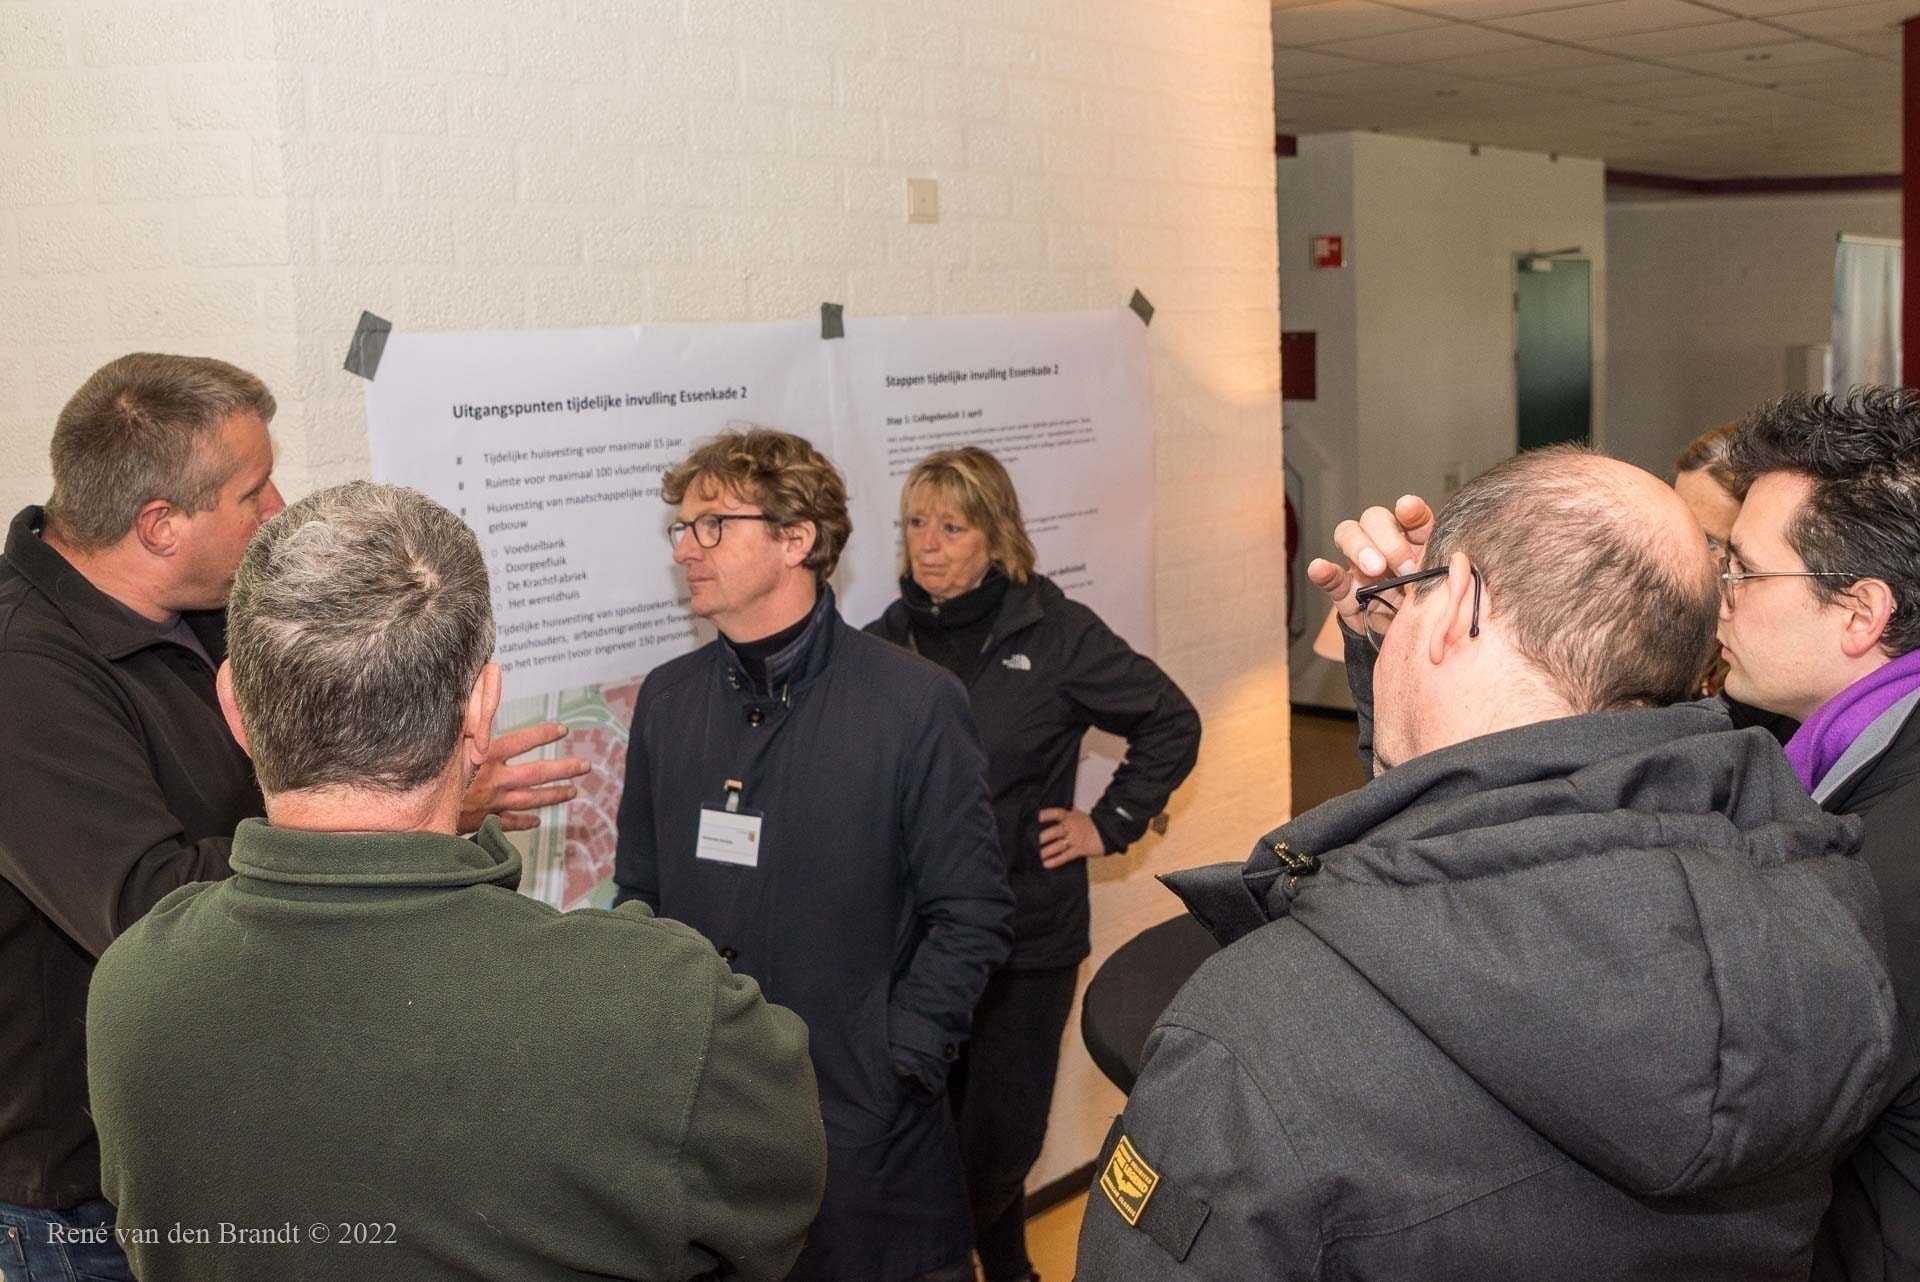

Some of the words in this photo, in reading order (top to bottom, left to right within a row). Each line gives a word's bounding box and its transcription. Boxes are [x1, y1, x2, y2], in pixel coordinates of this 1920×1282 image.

[886, 375, 924, 388] Stappen
[927, 370, 967, 386] tijdelijke
[970, 368, 1007, 381] invulling
[1009, 365, 1053, 379] Essenkade
[1054, 363, 1060, 376] 2
[453, 400, 563, 420] Uitgangspunten
[566, 395, 622, 413] tijdelijke
[625, 391, 677, 407] invulling
[680, 386, 738, 404] Essenkade
[741, 385, 748, 399] 2
[484, 450, 529, 466] Tijdelijke
[531, 446, 584, 461] huisvesting
[586, 445, 606, 455] voor
[609, 439, 651, 453] maximaal
[653, 438, 664, 449] 15
[485, 475, 521, 489] Ruimte
[524, 473, 546, 485] voor
[549, 468, 593, 482] maximaal
[596, 466, 613, 479] 100
[487, 498, 545, 514] Huisvesting
[546, 497, 563, 508] van
[565, 487, 643, 506] maatschappelijke
[489, 519, 528, 535] gebouw
[504, 538, 566, 555] Voedselbank
[506, 555, 567, 573] Doorgeefluik
[507, 580, 520, 592] De
[509, 598, 525, 609] Het
[528, 589, 580, 606] wereldhuis
[542, 611, 595, 629] huisvesting
[597, 609, 614, 619] van
[501, 660, 514, 672] op
[515, 657, 532, 669] het
